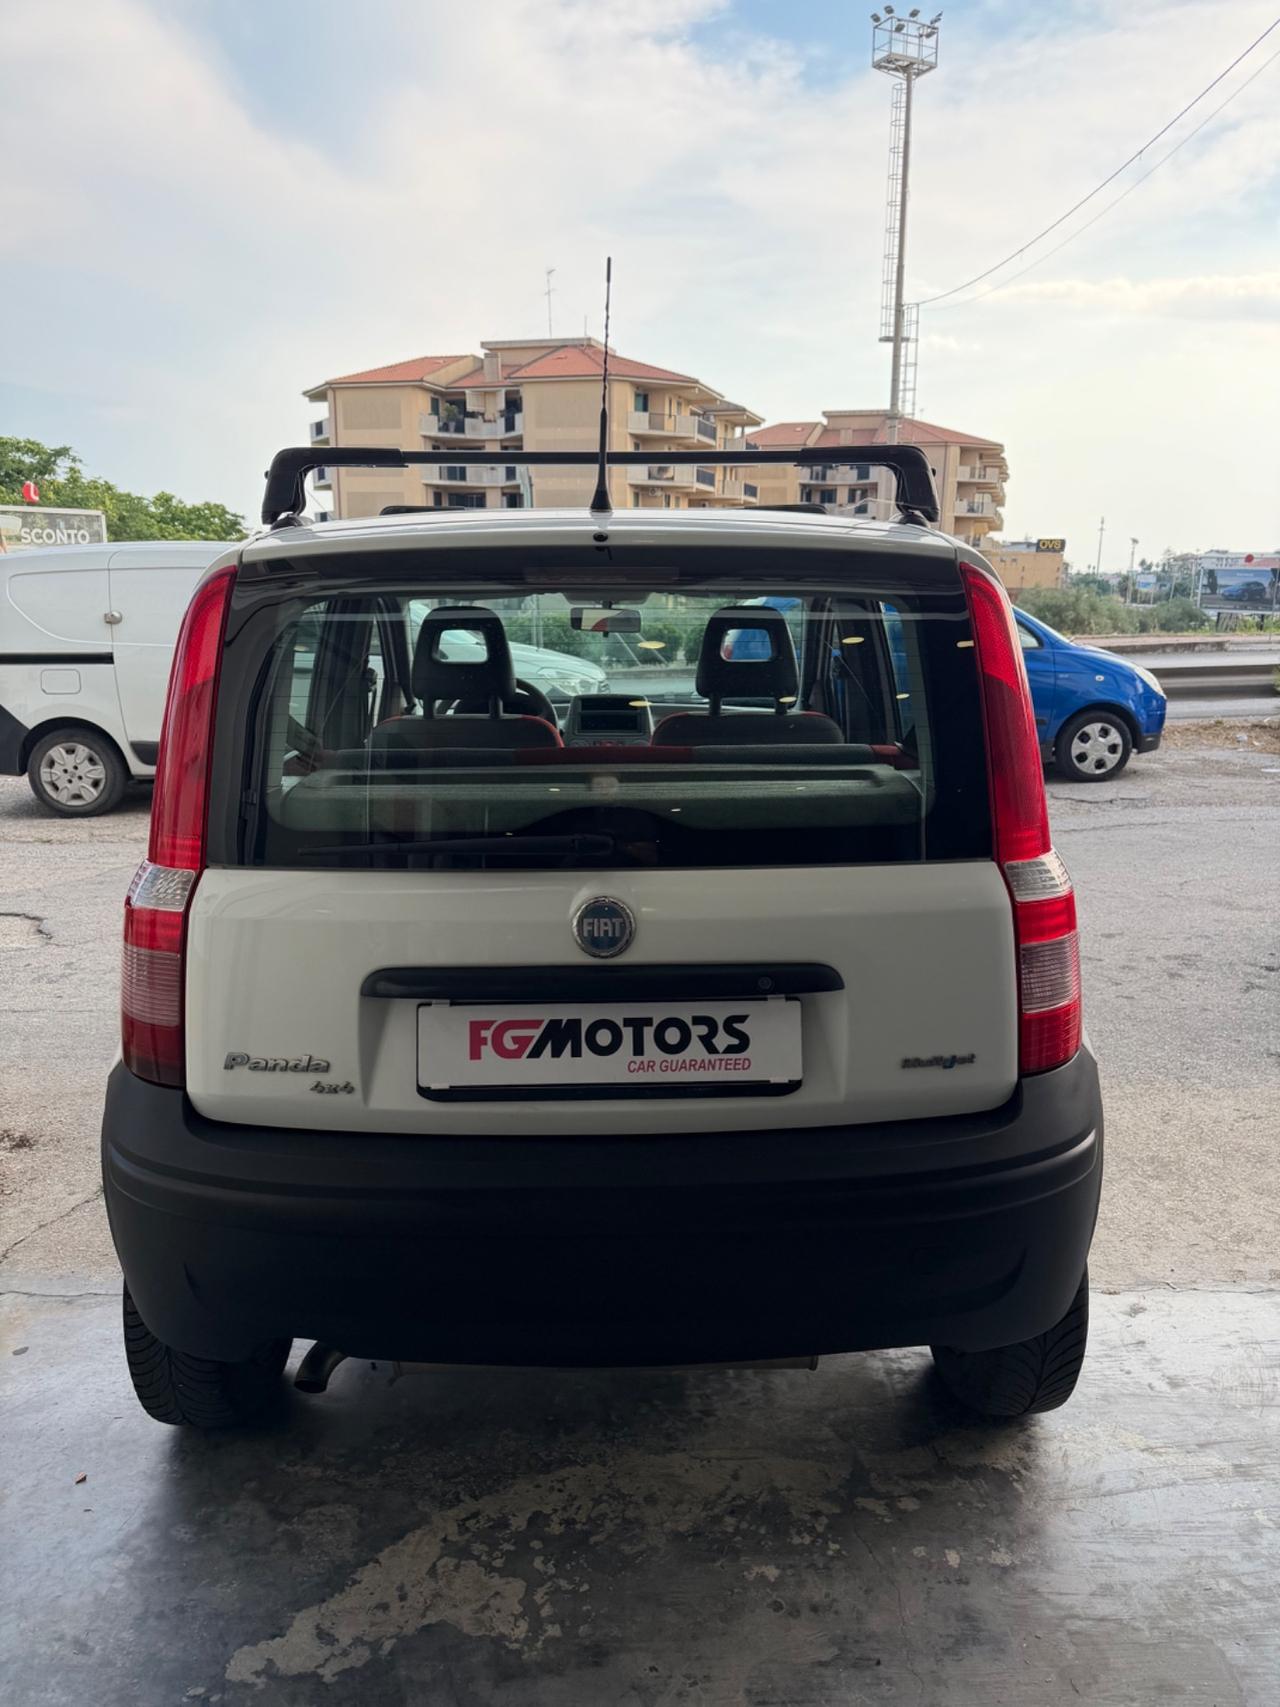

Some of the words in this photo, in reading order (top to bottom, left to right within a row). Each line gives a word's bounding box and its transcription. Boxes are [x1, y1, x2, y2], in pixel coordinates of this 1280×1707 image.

[21, 527, 90, 544] SCONTO
[1039, 540, 1062, 549] OVS
[583, 918, 624, 937] FIAT
[223, 1052, 330, 1073] Panda
[627, 1060, 656, 1073] CAR
[659, 1058, 752, 1072] GUARANTEED
[310, 1081, 355, 1094] 4x4
